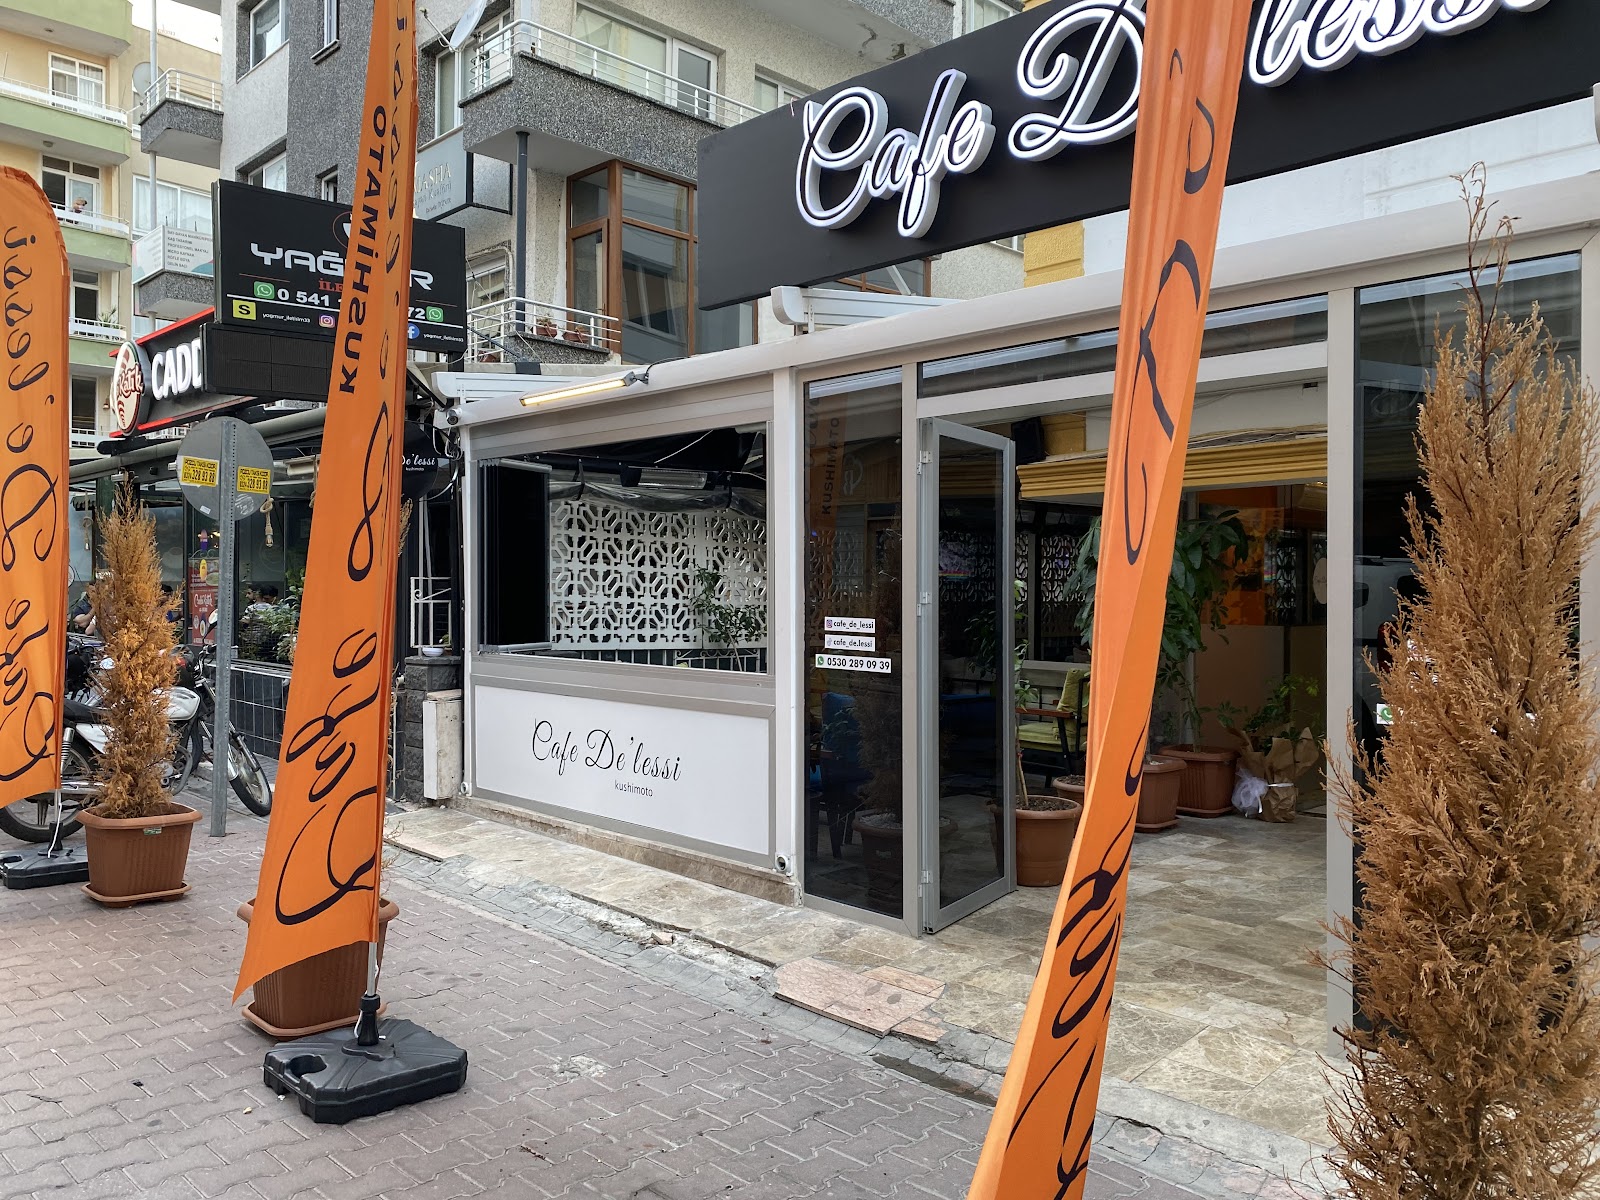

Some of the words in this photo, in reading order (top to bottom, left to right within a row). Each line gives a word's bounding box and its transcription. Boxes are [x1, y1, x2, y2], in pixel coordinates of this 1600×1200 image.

[796, 68, 996, 239] Cafe
[277, 288, 290, 301] 0
[296, 290, 330, 307] 541
[833, 620, 874, 630] cafe_de_lessi
[833, 638, 873, 648] cafe_de.lessi
[827, 657, 847, 667] 0530
[849, 658, 864, 668] 289
[866, 660, 877, 669] 09
[880, 661, 890, 670] 39
[532, 718, 579, 776] Cafe
[585, 728, 682, 781] De'lessi
[614, 780, 654, 797] kushimoto
